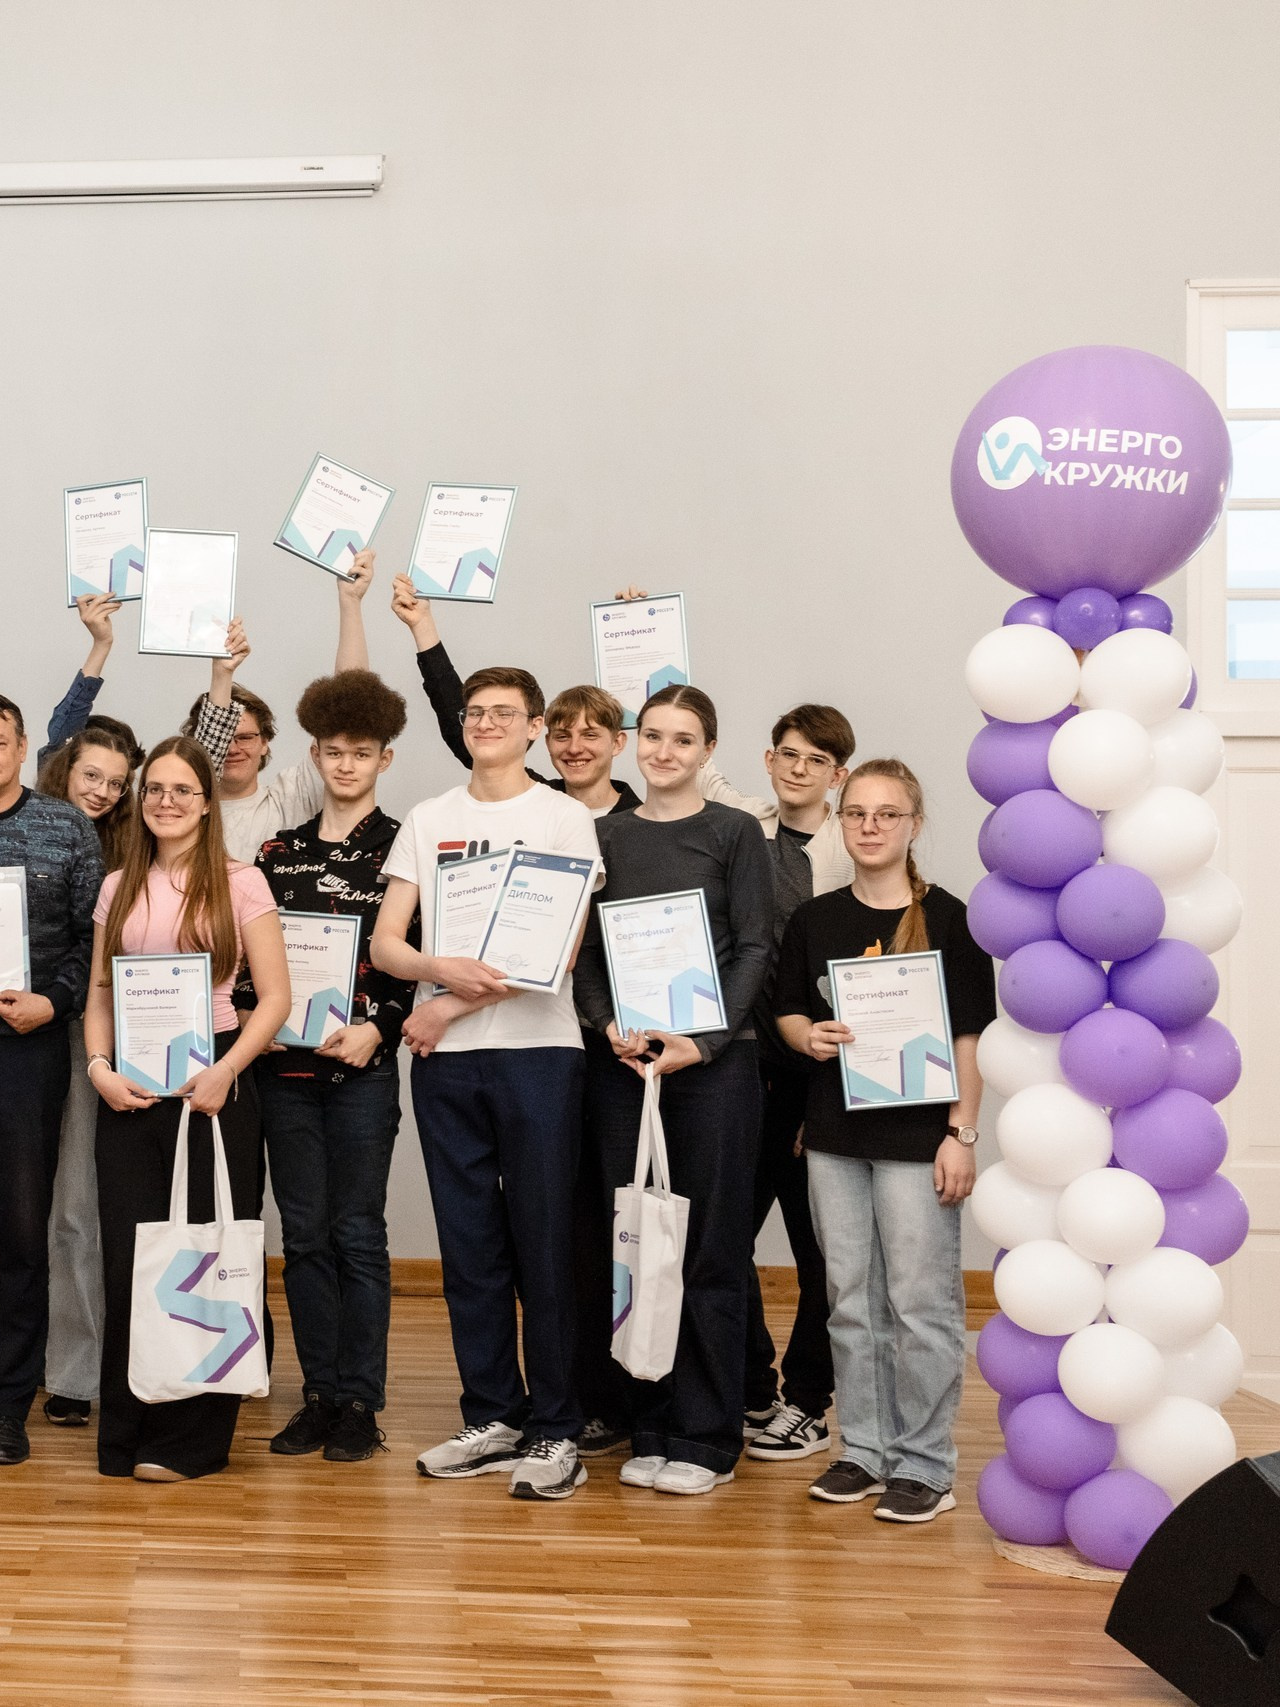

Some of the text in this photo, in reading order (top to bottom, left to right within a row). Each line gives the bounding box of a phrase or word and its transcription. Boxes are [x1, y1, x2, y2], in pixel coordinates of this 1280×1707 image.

[1045, 427, 1183, 459] ЭНЕРГО
[1043, 461, 1189, 495] КРУЖКИ
[316, 478, 361, 504] Сертификат
[75, 509, 122, 521] Сертификат
[433, 508, 484, 518] Сертификат
[603, 626, 657, 639] Сертификат
[320, 873, 350, 890] NIKE
[447, 882, 497, 899] Сертификат
[507, 889, 554, 903] ДИПЛОМ
[615, 926, 675, 941] Сертификат
[125, 987, 181, 997] Сертификат
[846, 989, 910, 1001] Сертификат
